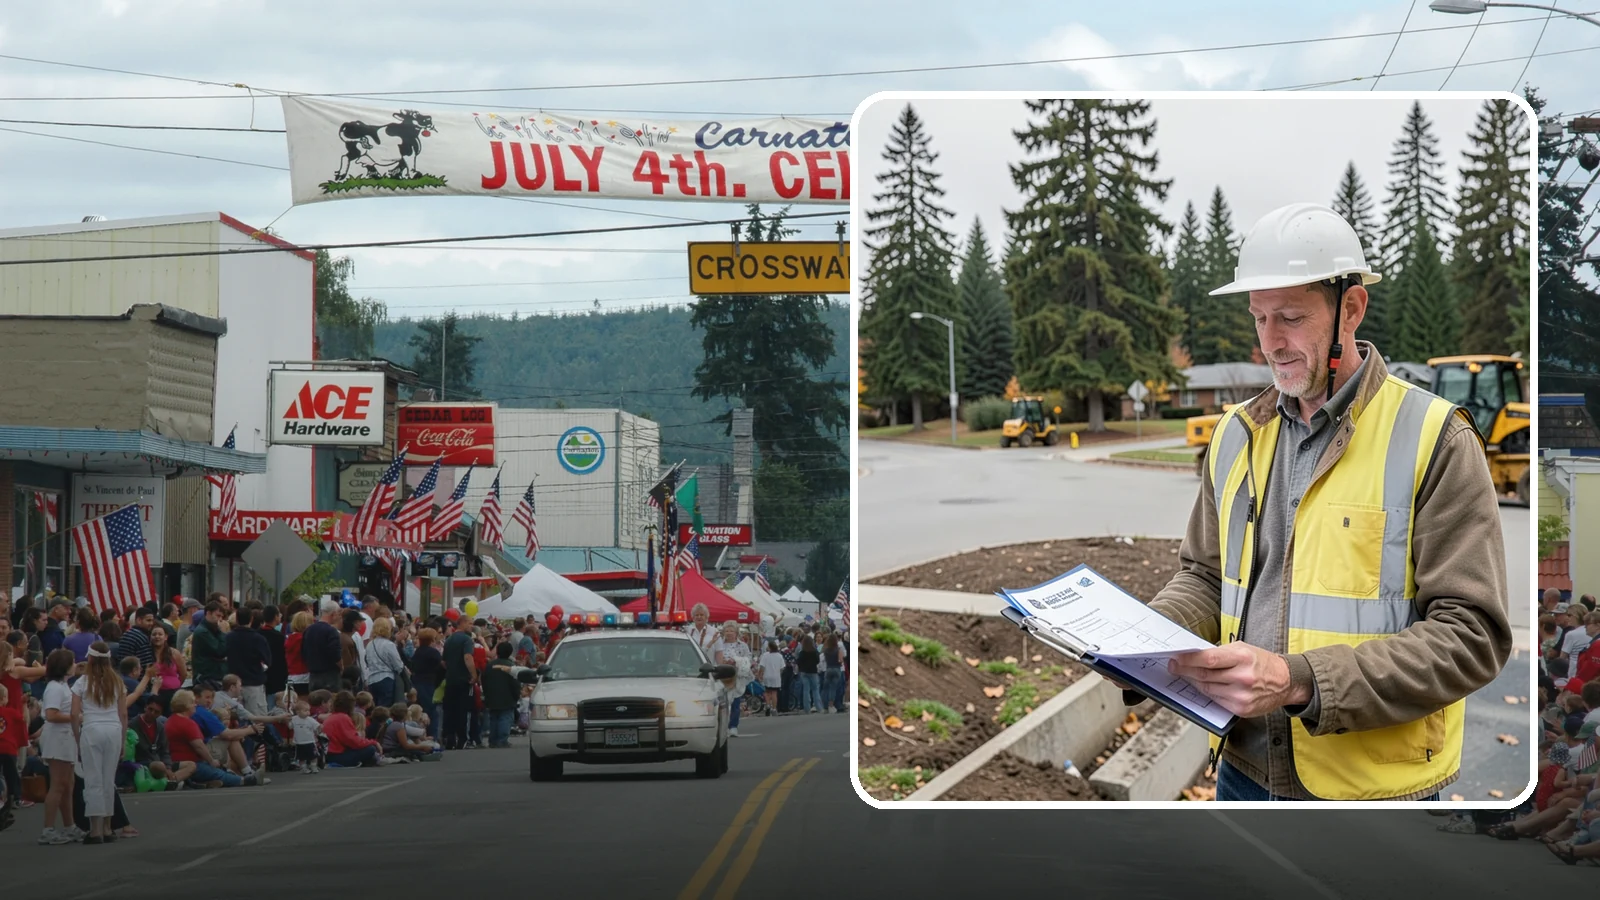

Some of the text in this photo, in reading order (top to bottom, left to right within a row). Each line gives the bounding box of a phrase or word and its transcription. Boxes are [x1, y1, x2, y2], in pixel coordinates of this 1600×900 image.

[695, 121, 850, 150] Carnat
[481, 141, 605, 193] JULY
[632, 150, 746, 198] 4th.
[697, 254, 850, 280] CROSSWA
[283, 380, 373, 420] ACE
[405, 409, 485, 422] CEDAR LOG
[283, 421, 371, 437] Hardware
[416, 428, 477, 447] Coca-Cola
[353, 467, 384, 479] Simpl
[96, 485, 124, 494] Vincent
[126, 486, 136, 495] de
[138, 486, 155, 495] Paul
[212, 516, 331, 536] HARDARE
[688, 526, 741, 535] CRNATION
[699, 535, 730, 543] GLASS
